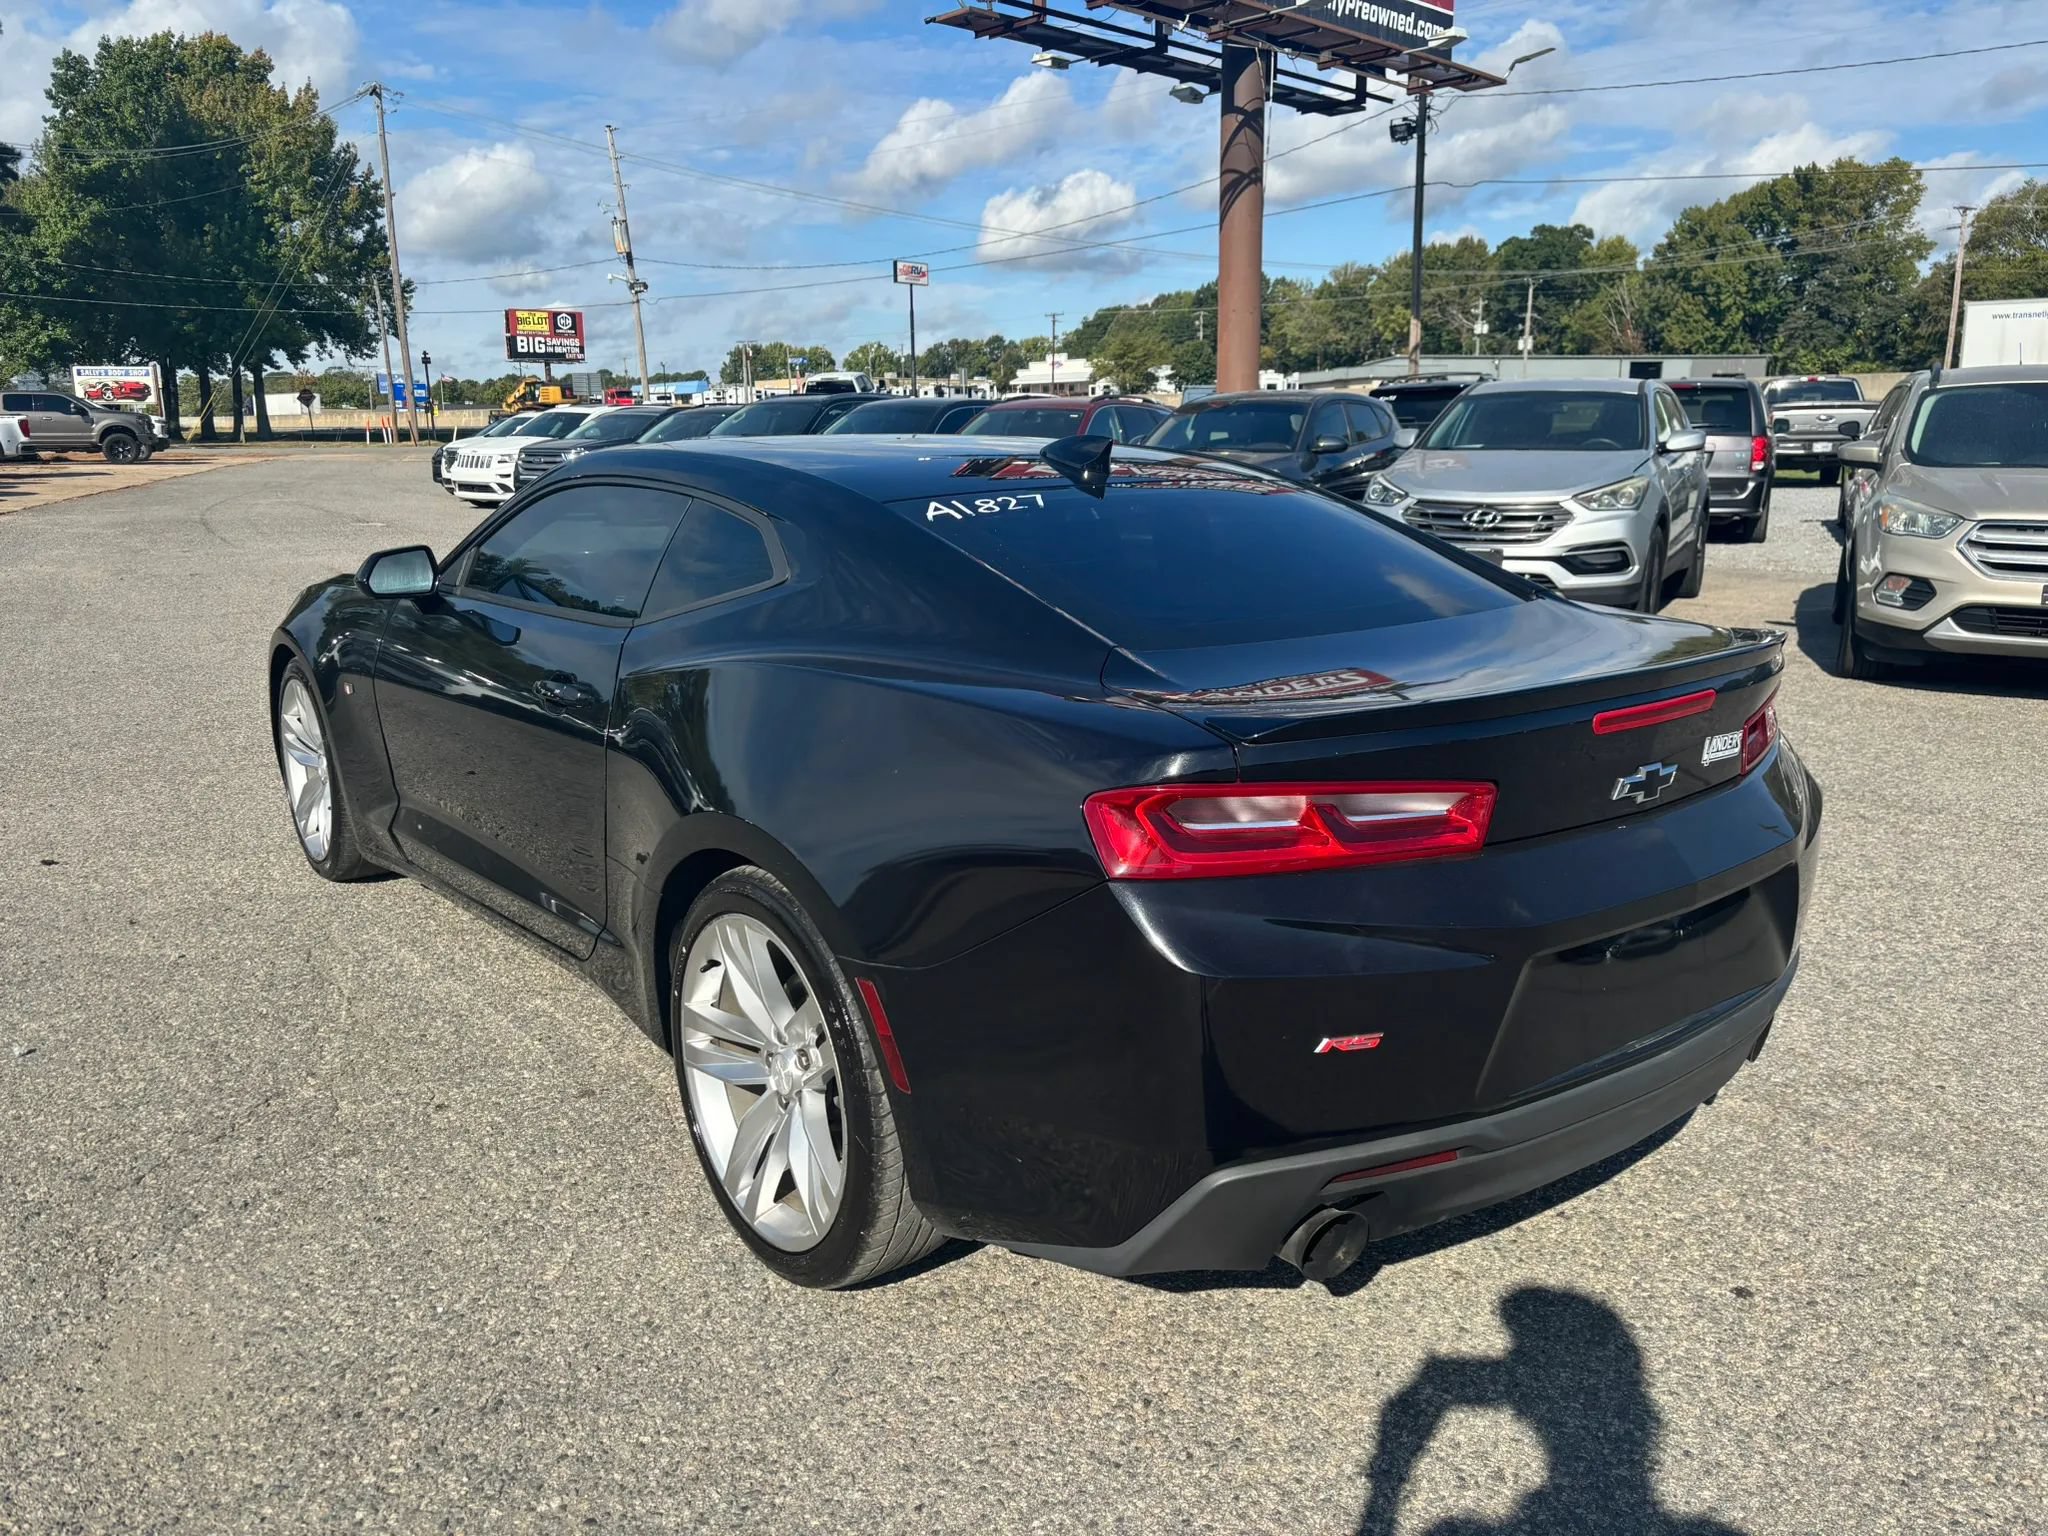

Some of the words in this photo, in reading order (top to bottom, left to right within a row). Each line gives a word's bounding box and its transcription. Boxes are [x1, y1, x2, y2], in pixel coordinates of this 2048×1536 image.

[517, 317, 531, 325] BIG
[532, 317, 548, 325] LOT
[517, 336, 545, 353] BIG
[546, 338, 580, 346] SAVINGS
[107, 368, 125, 376] BODY
[128, 368, 146, 376] SHOP
[1313, 1032, 1384, 1053] RS
